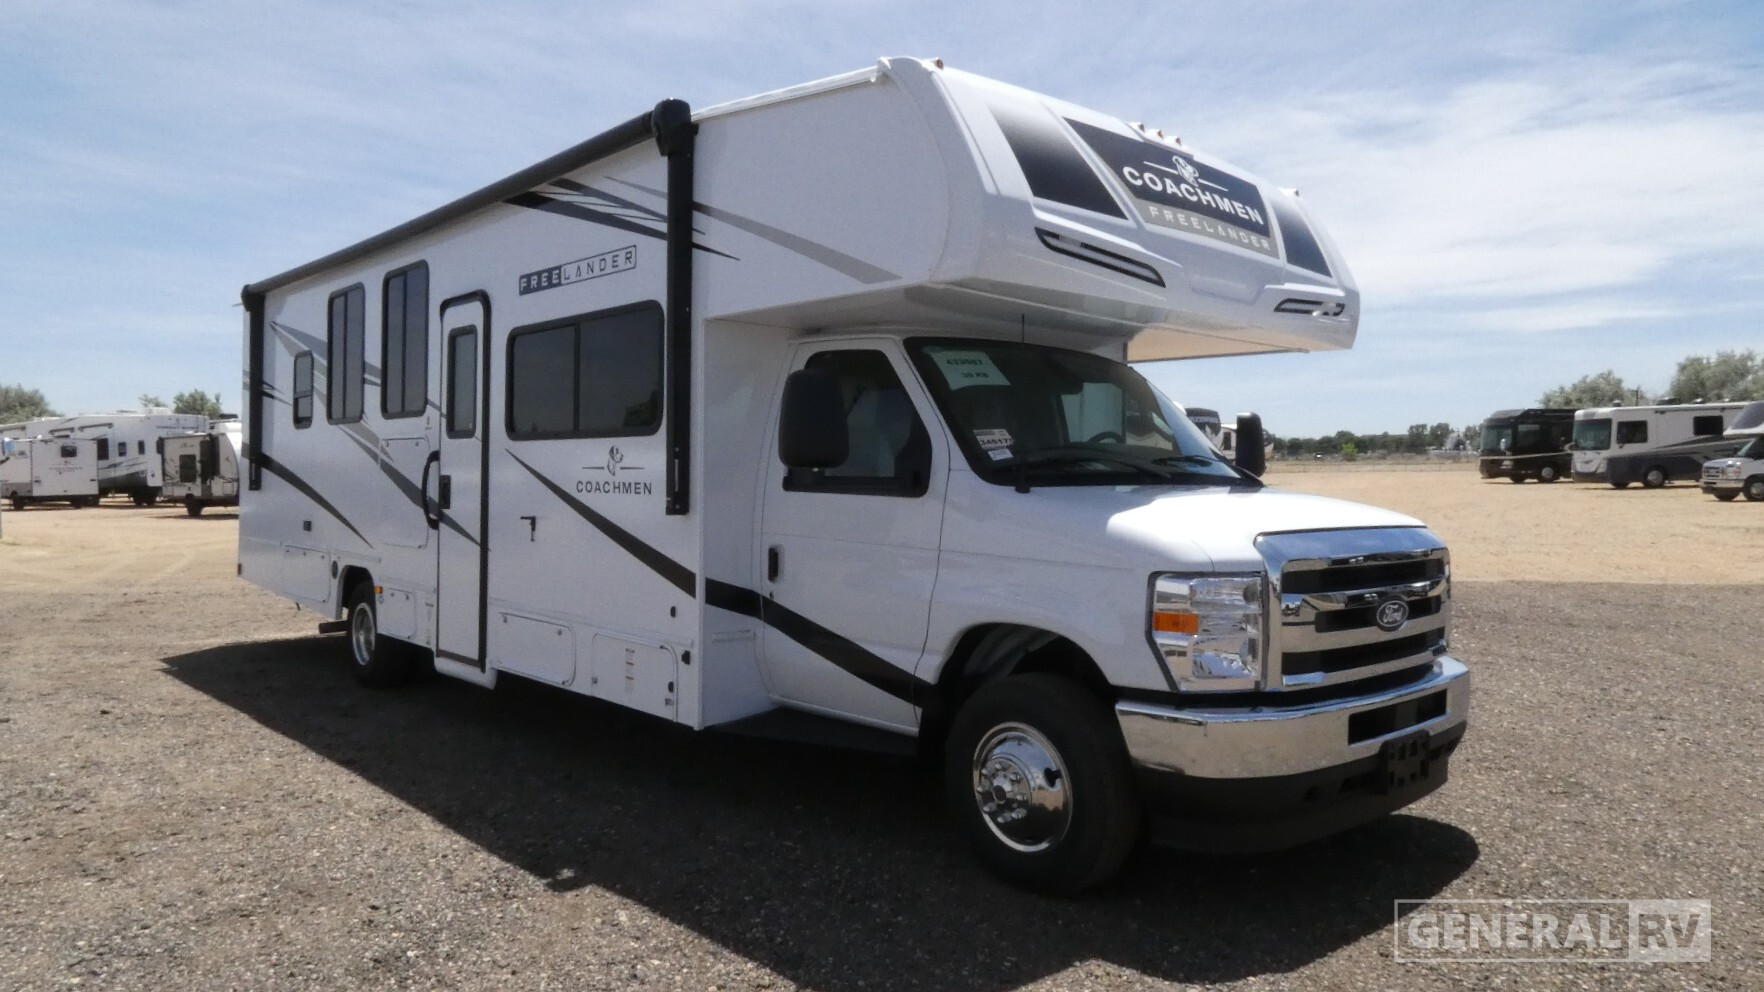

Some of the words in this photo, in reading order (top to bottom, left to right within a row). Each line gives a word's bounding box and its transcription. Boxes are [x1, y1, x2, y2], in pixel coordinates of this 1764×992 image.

[1122, 166, 1264, 225] COACHMEN
[1148, 205, 1271, 250] FREELANDER
[520, 250, 634, 292] FREELANDER
[576, 481, 652, 495] COACHMEN
